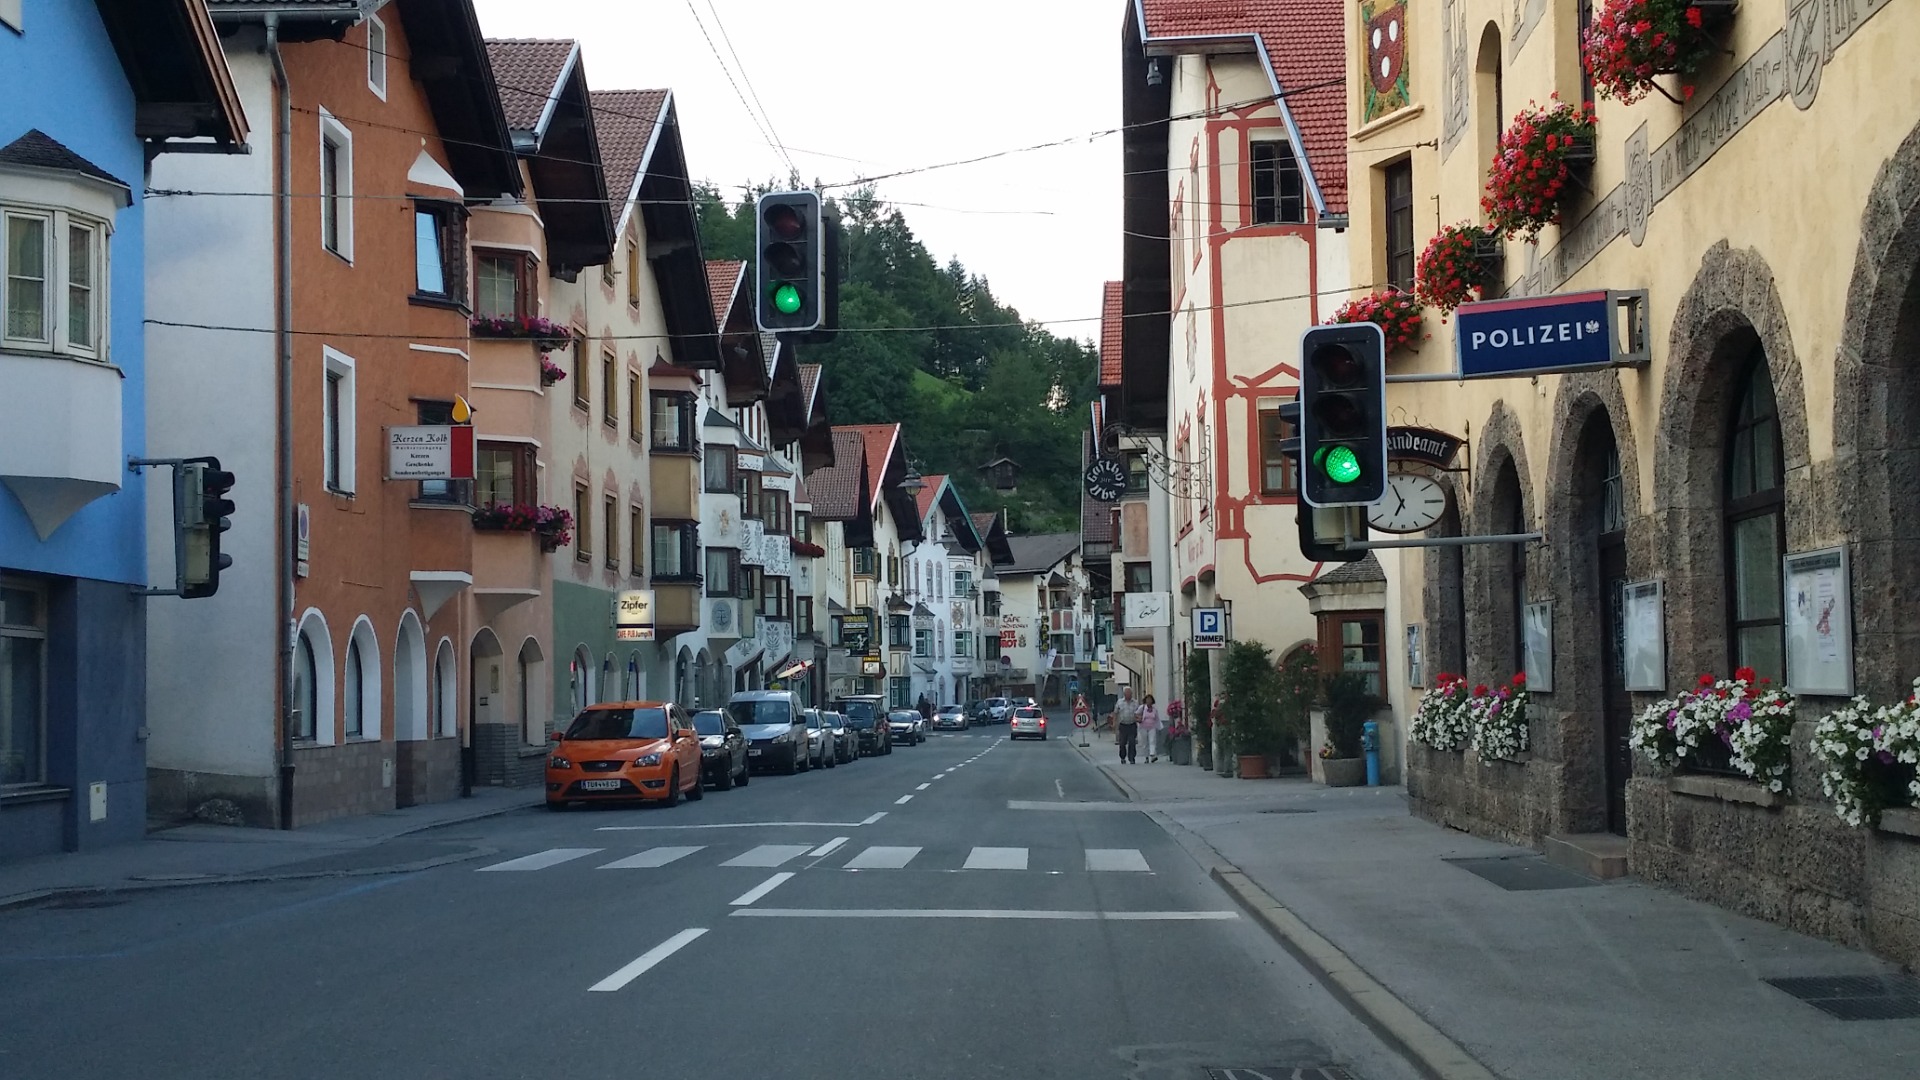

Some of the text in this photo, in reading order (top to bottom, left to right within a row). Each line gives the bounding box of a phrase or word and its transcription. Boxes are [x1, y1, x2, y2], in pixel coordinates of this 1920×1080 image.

[1472, 322, 1582, 350] POLIZEI
[392, 433, 448, 443] Kerzen Kolb
[1386, 432, 1448, 457] eindeamt
[621, 600, 648, 611] Zipfer
[1194, 635, 1224, 643] ZIMMER
[1077, 714, 1087, 725] 30
